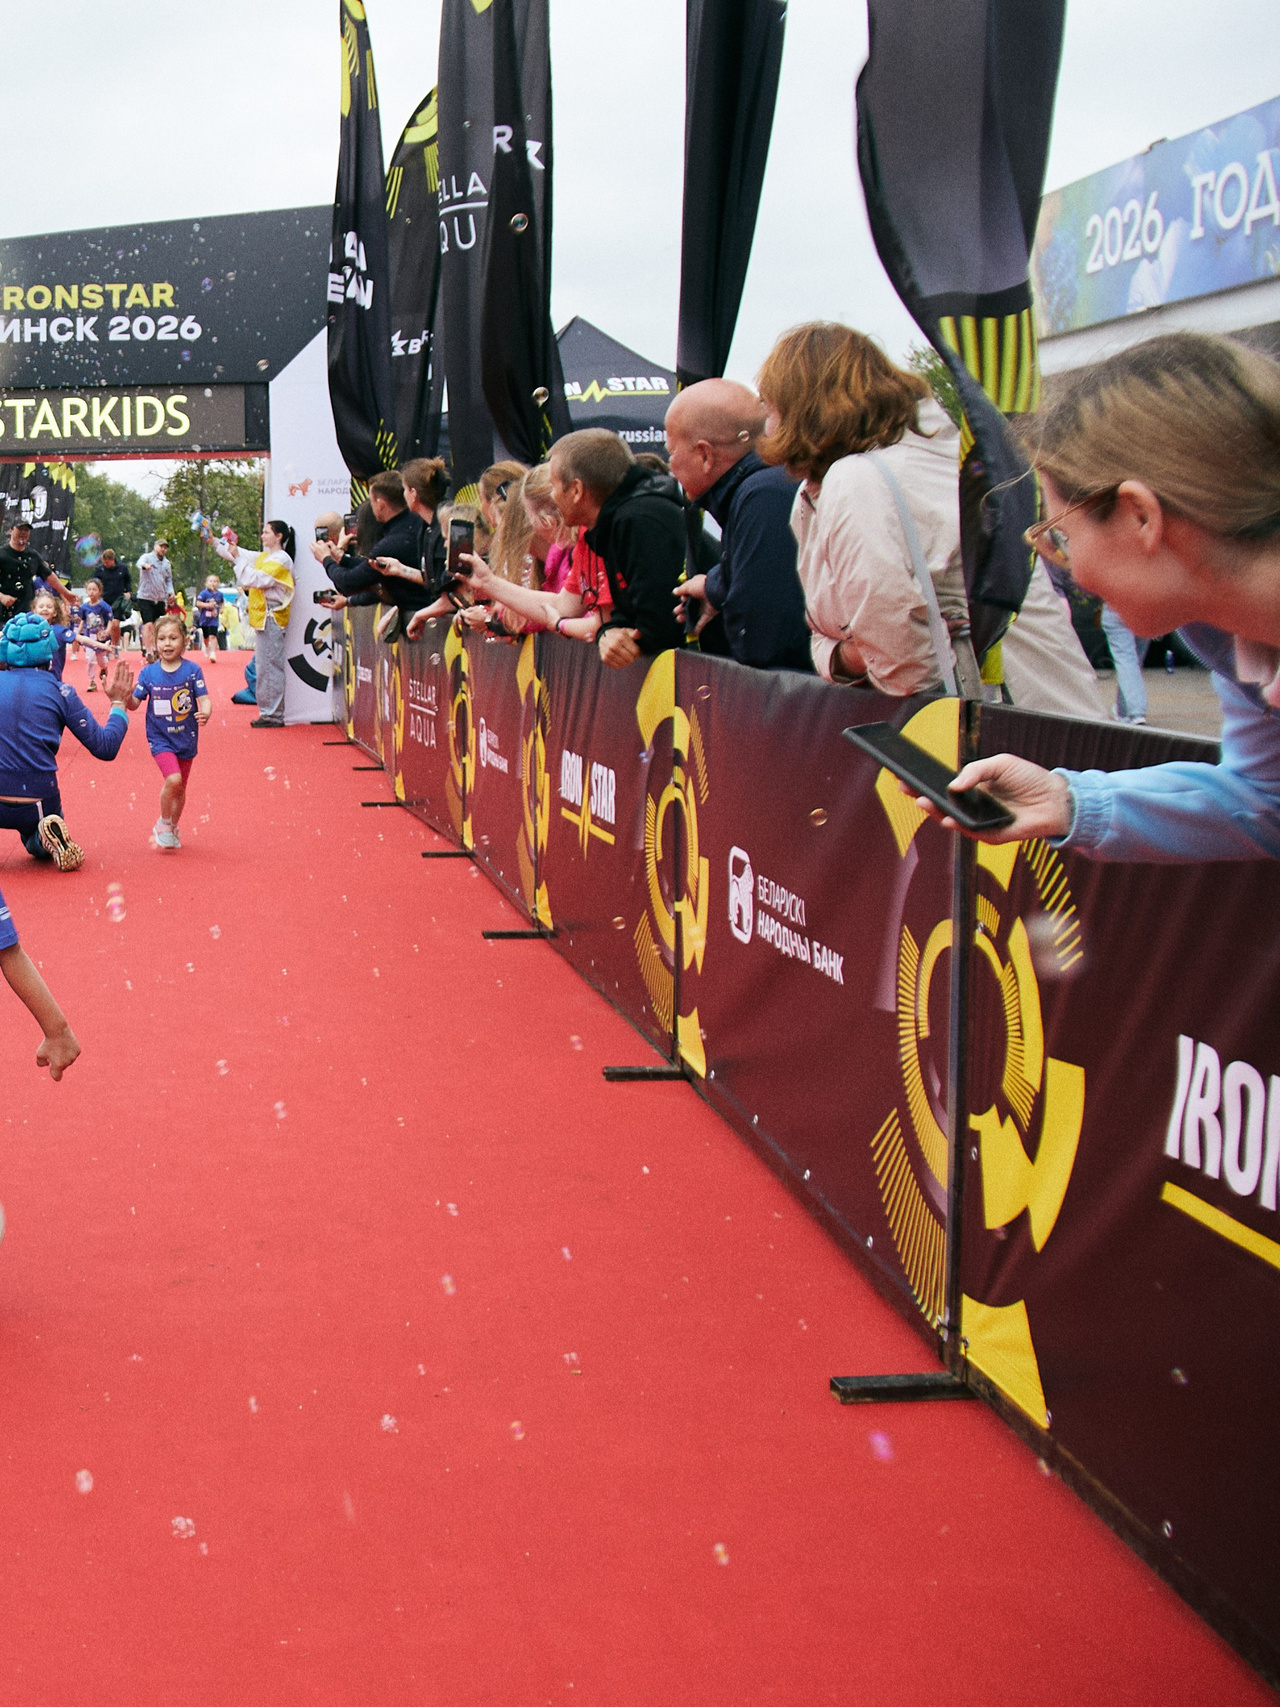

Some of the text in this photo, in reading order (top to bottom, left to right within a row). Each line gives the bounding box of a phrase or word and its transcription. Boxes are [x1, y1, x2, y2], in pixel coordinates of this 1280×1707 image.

[1085, 191, 1164, 274] 2026
[108, 315, 202, 341] 2026
[607, 376, 669, 391] STAR
[410, 713, 437, 749] AQUA
[560, 749, 583, 807] IRON
[590, 761, 616, 825] STAR
[757, 909, 844, 985] НАРОДНЫ БАНК
